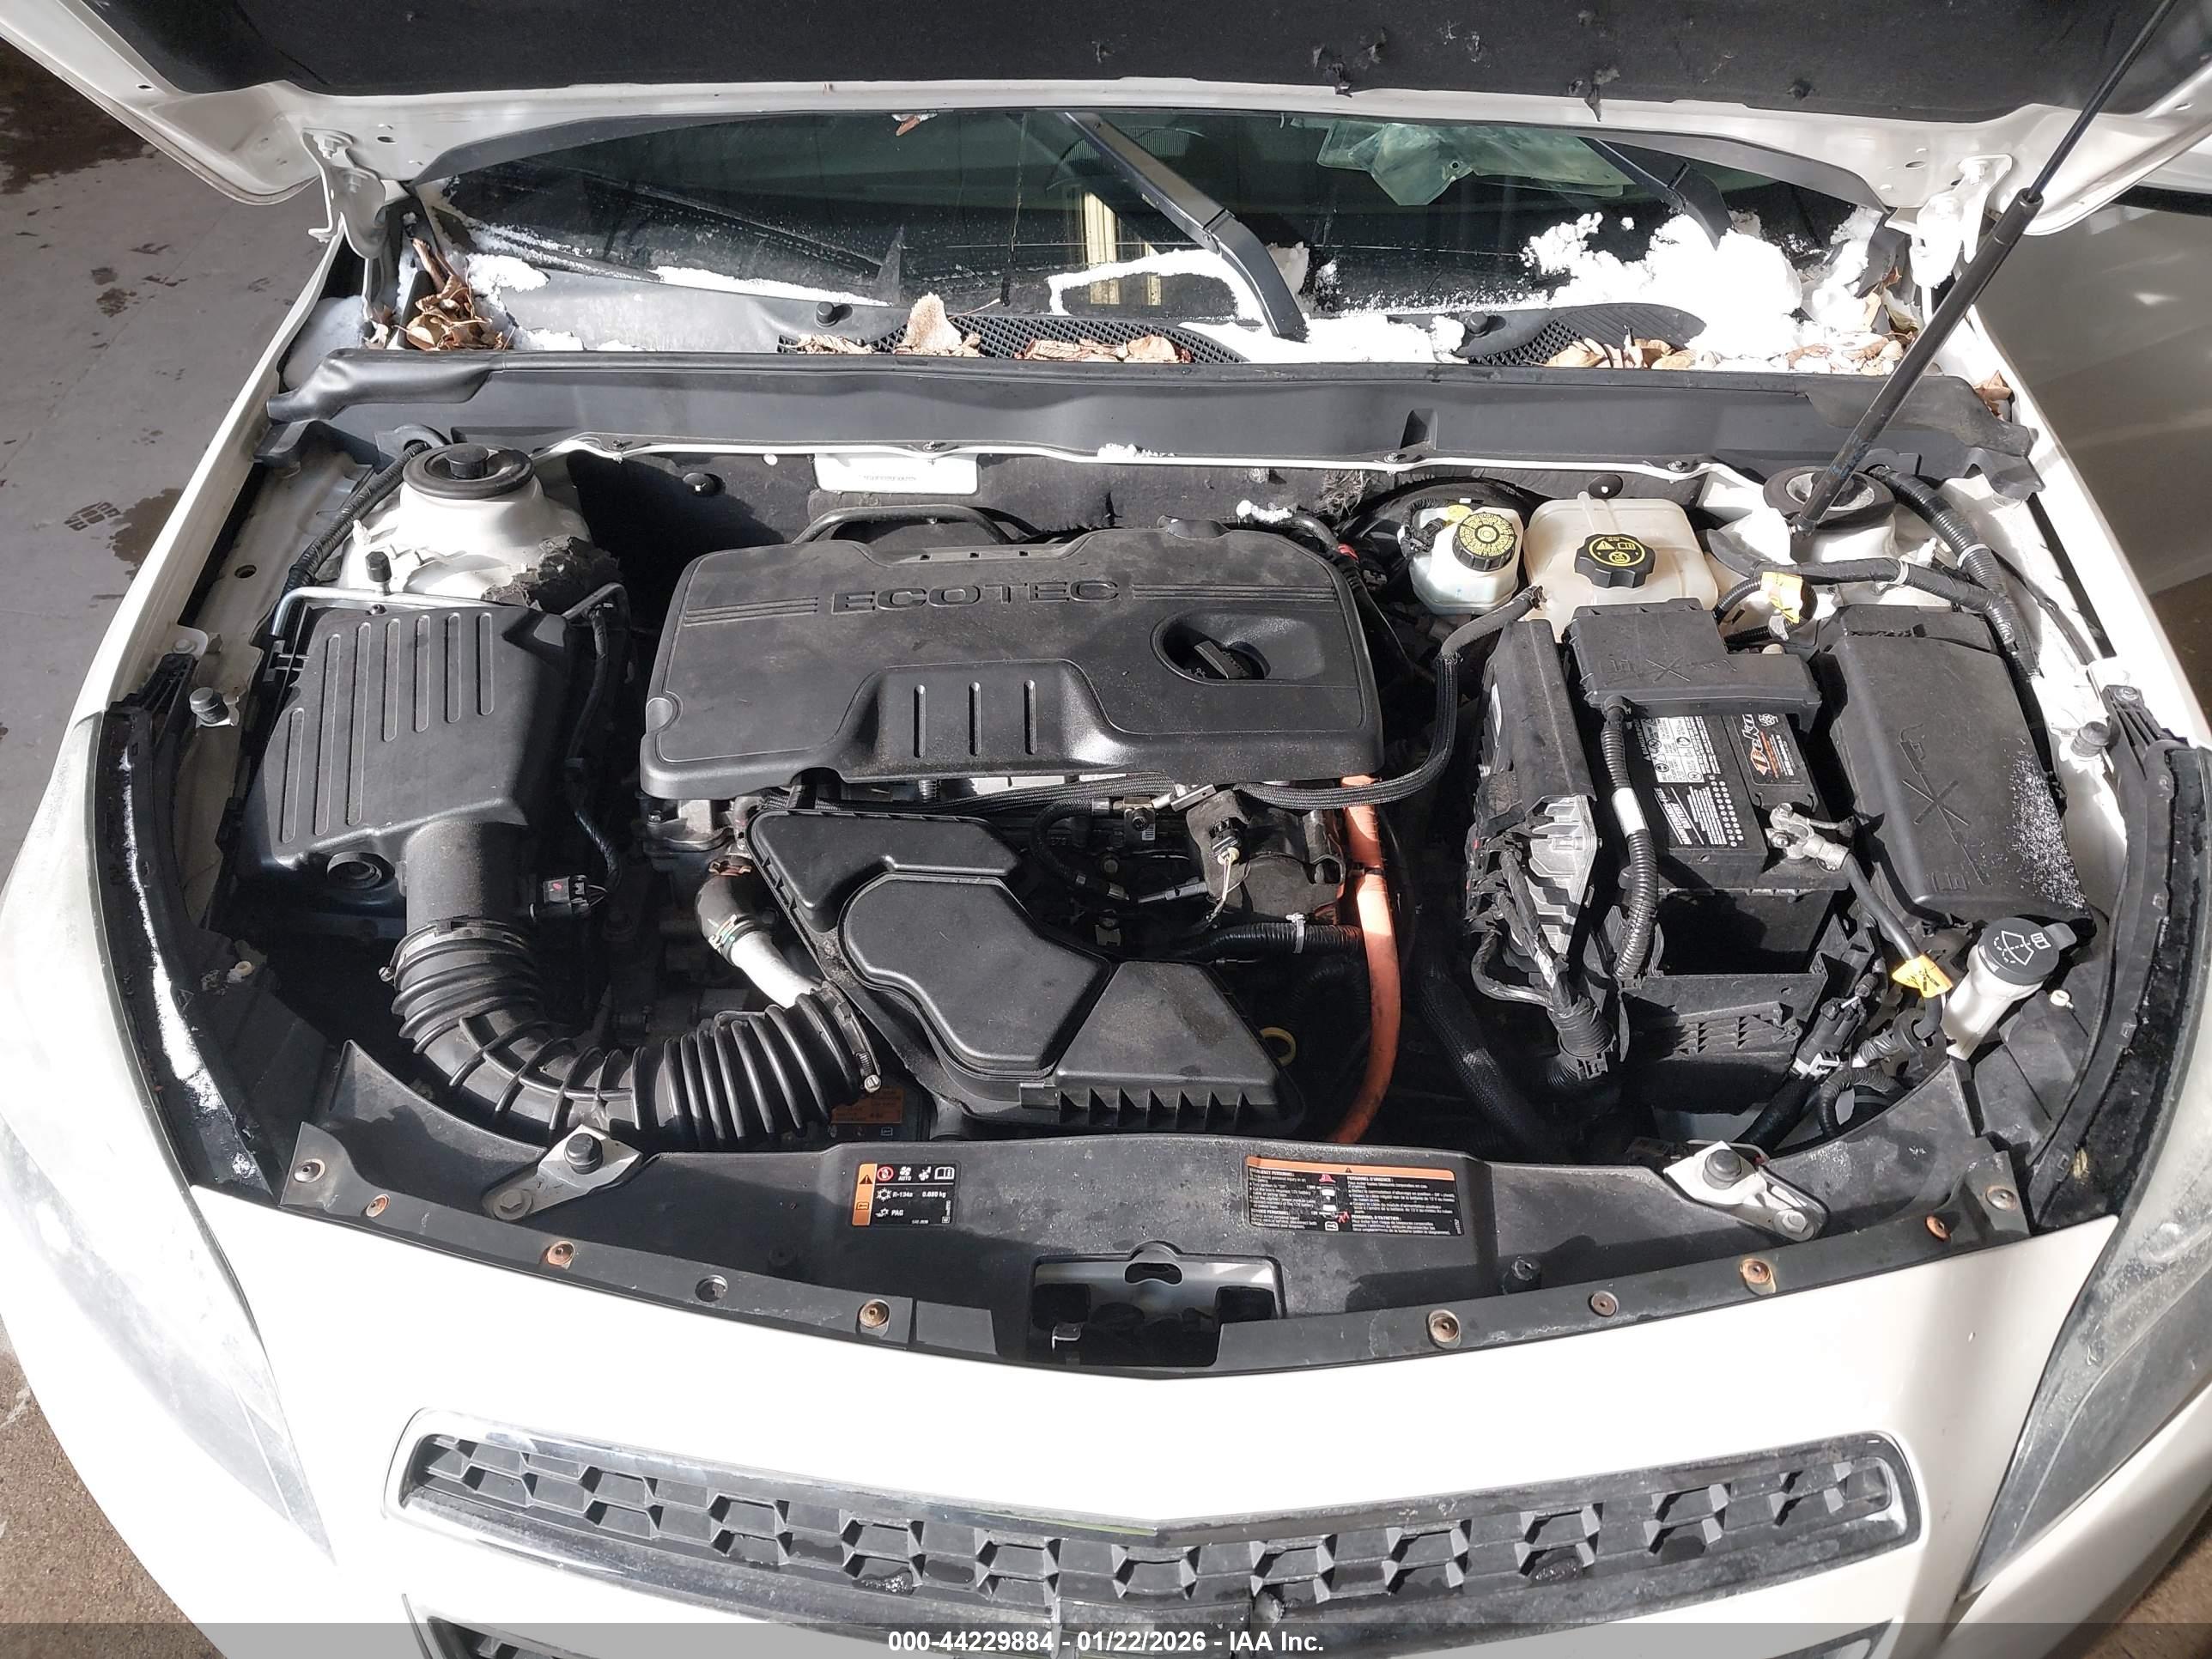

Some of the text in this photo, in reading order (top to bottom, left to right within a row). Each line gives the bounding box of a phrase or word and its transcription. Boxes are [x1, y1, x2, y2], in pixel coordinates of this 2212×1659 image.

[831, 580, 1120, 615] ECOTEC
[1654, 787, 1692, 845] MAINTENANCE-FREE
[1670, 802, 1692, 830] BATTERY
